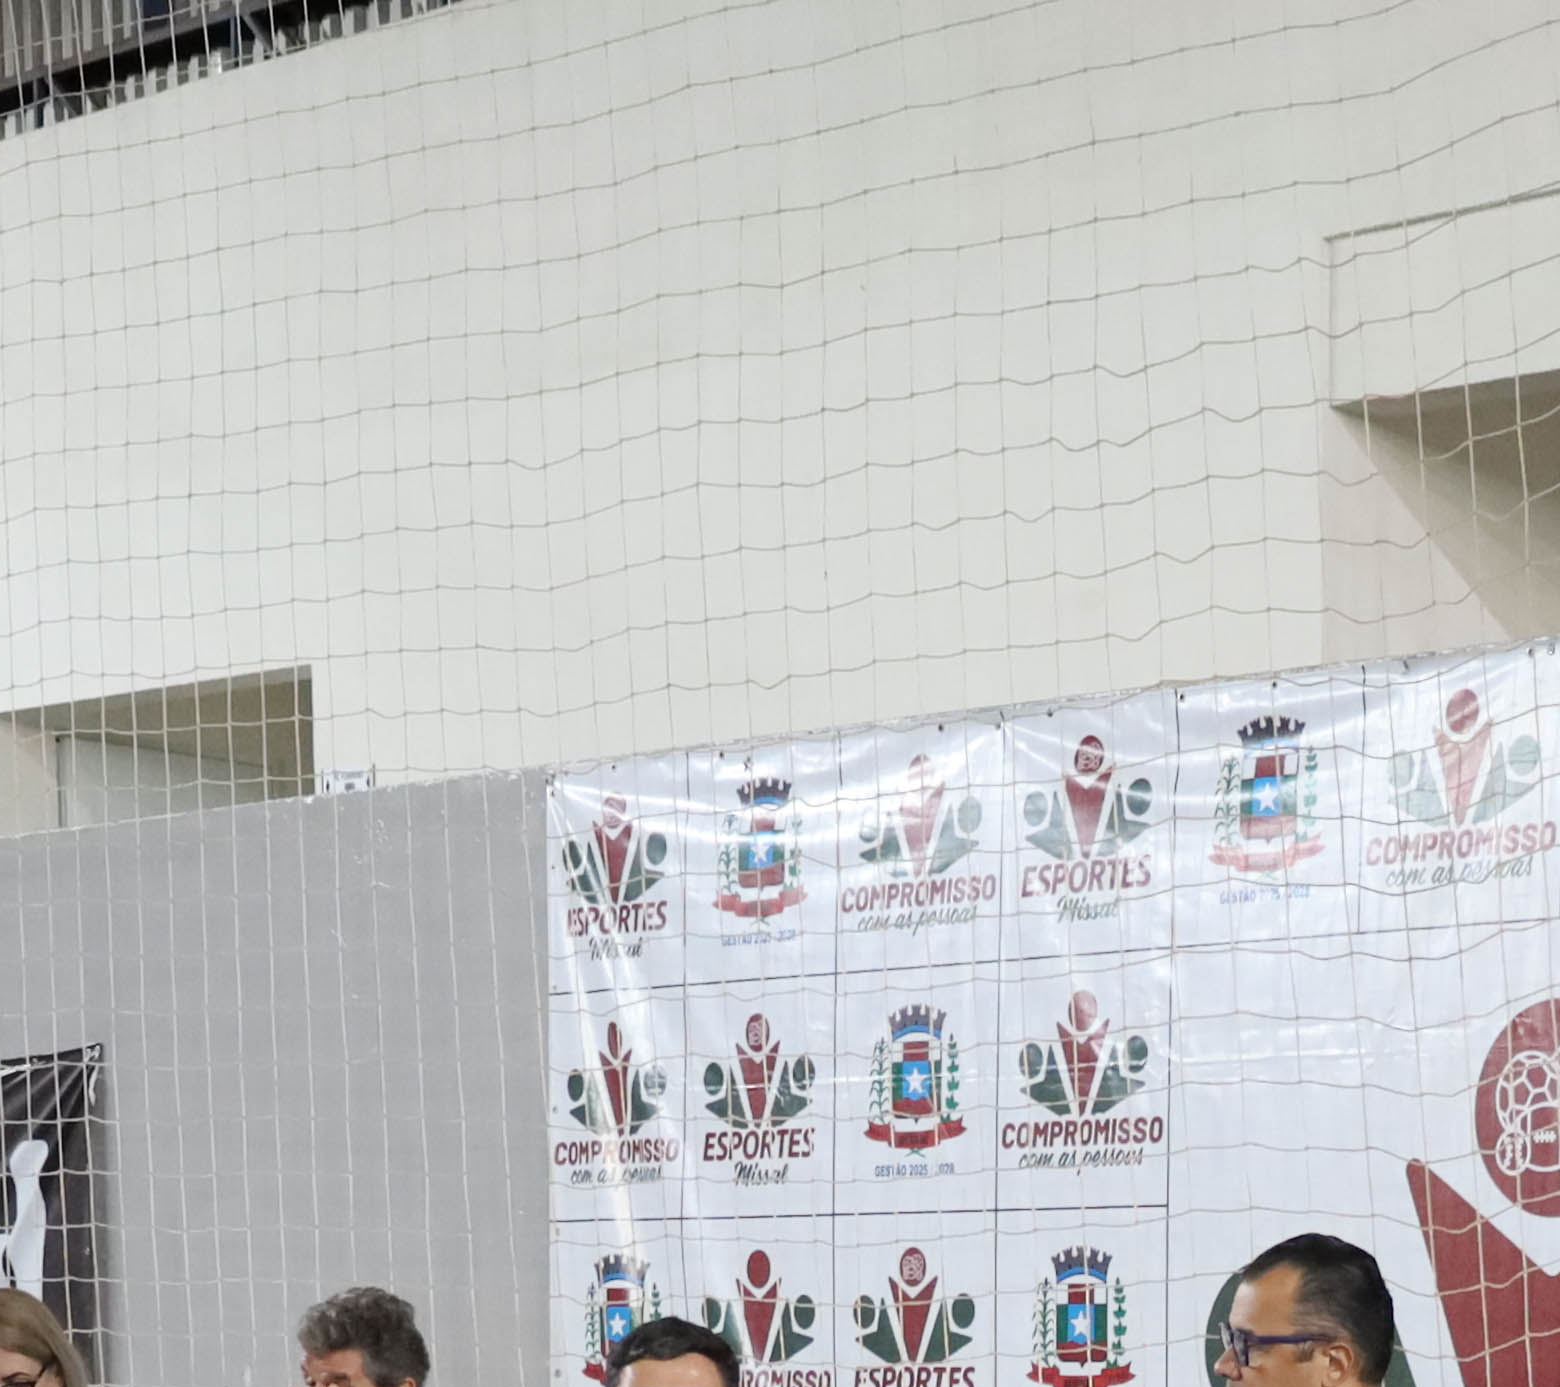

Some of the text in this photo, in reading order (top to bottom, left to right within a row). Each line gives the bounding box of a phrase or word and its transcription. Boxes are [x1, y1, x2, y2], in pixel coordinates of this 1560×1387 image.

[1365, 820, 1557, 867] COMPROMISSO
[840, 873, 997, 914] COMPROMISSO
[1020, 855, 1152, 899] ESPORTES
[554, 1137, 679, 1166] COMPOMSSO
[702, 1127, 816, 1162] ESPORTES
[1001, 1116, 1164, 1150] COMPROMISSO
